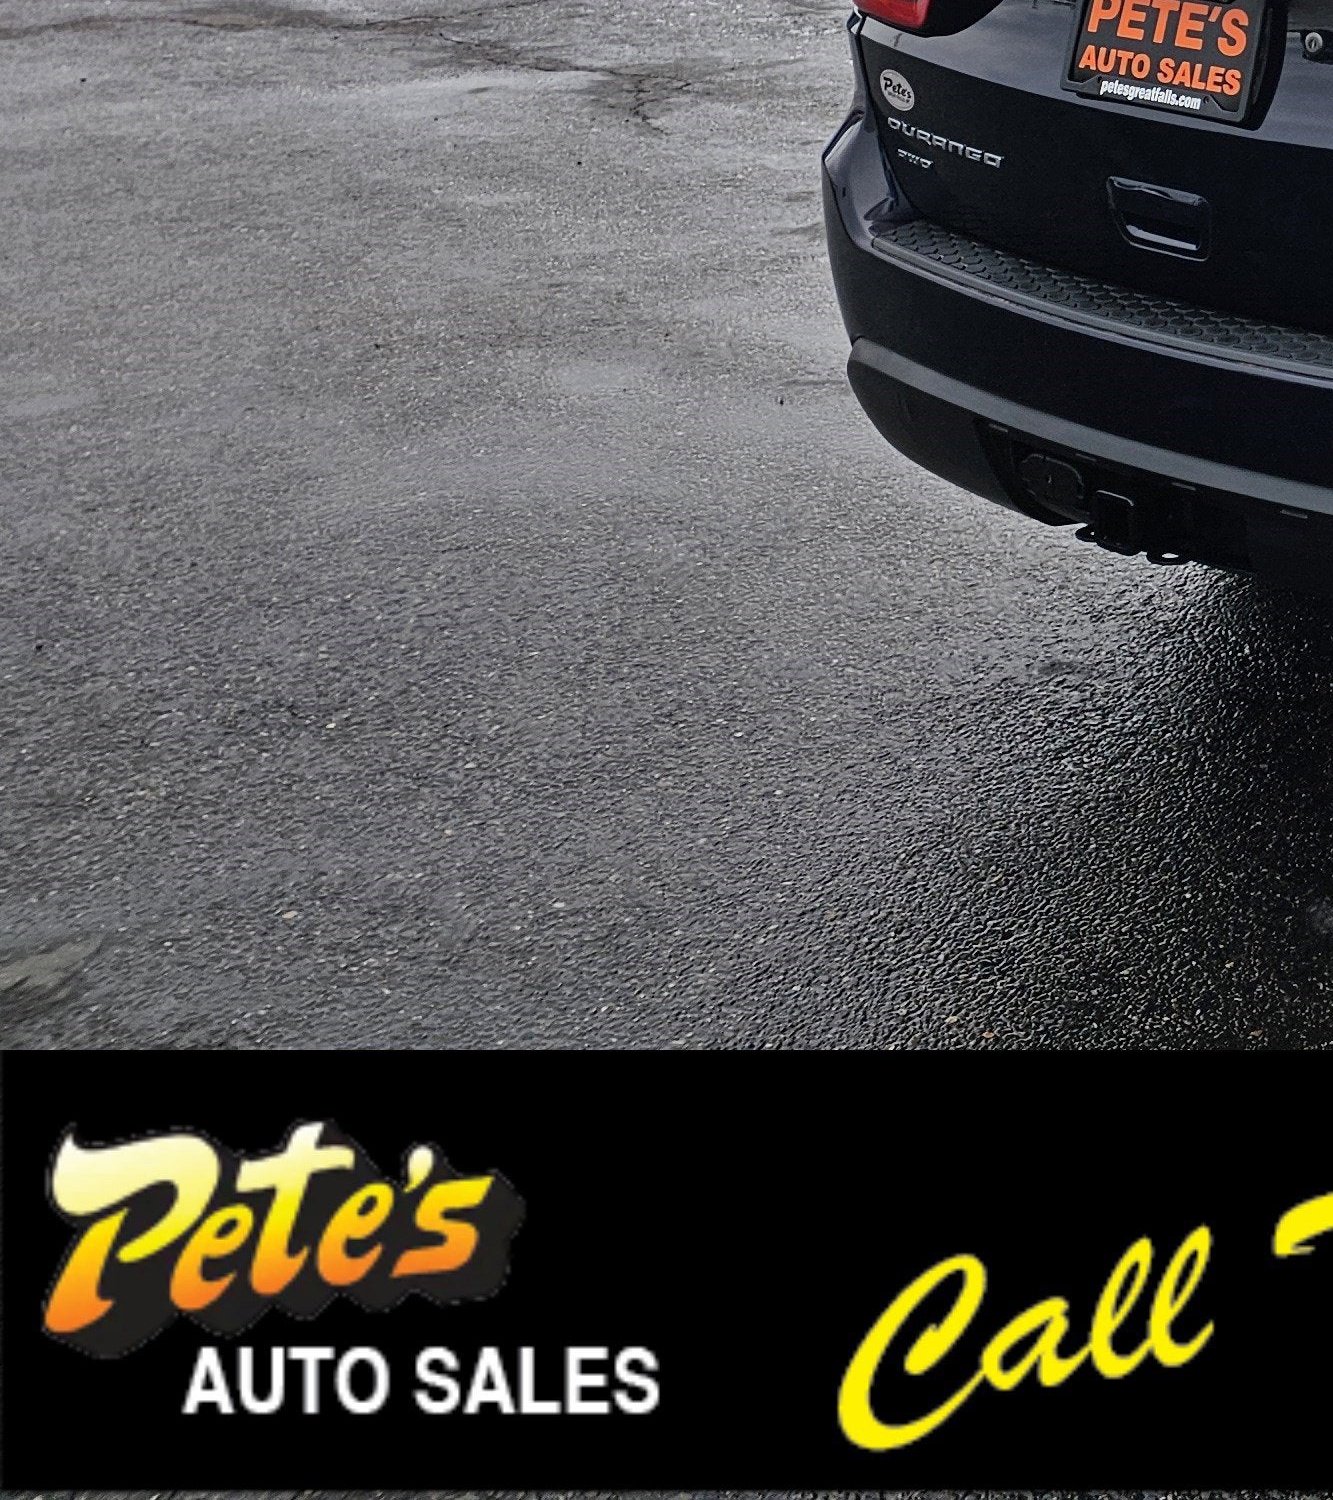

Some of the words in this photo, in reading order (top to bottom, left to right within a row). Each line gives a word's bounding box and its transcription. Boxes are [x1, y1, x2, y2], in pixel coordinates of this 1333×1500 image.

[1078, 44, 1151, 79] AUTO
[1156, 57, 1242, 96] SALES
[1100, 79, 1201, 110] petesgreatfalls.com
[887, 116, 1005, 169] DURANGO
